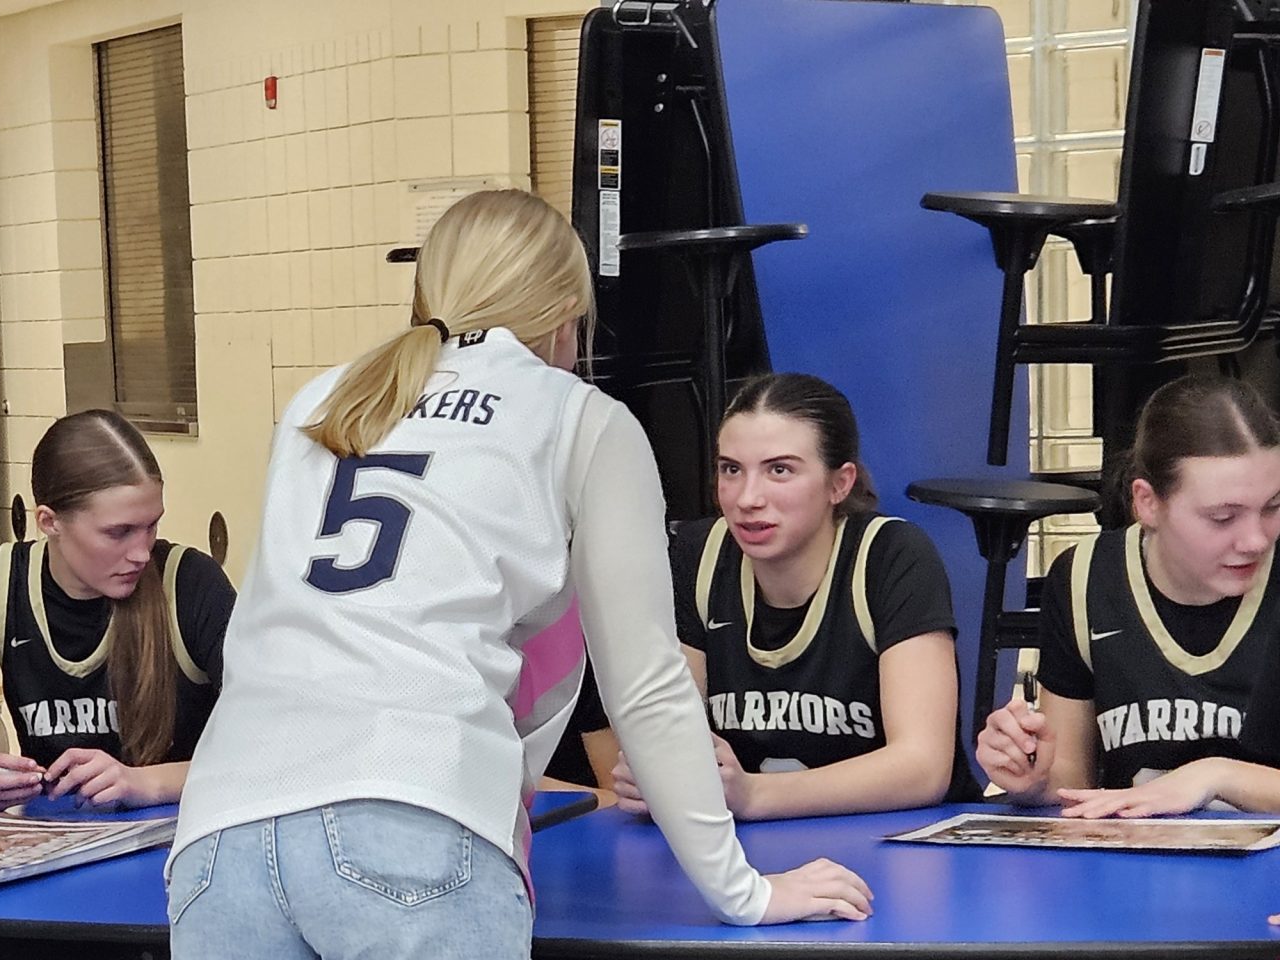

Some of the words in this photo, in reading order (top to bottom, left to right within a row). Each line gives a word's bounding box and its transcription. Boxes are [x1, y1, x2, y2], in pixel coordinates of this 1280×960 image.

[401, 389, 501, 426] KERS
[302, 451, 436, 595] 5
[1096, 698, 1247, 752] WARRIO
